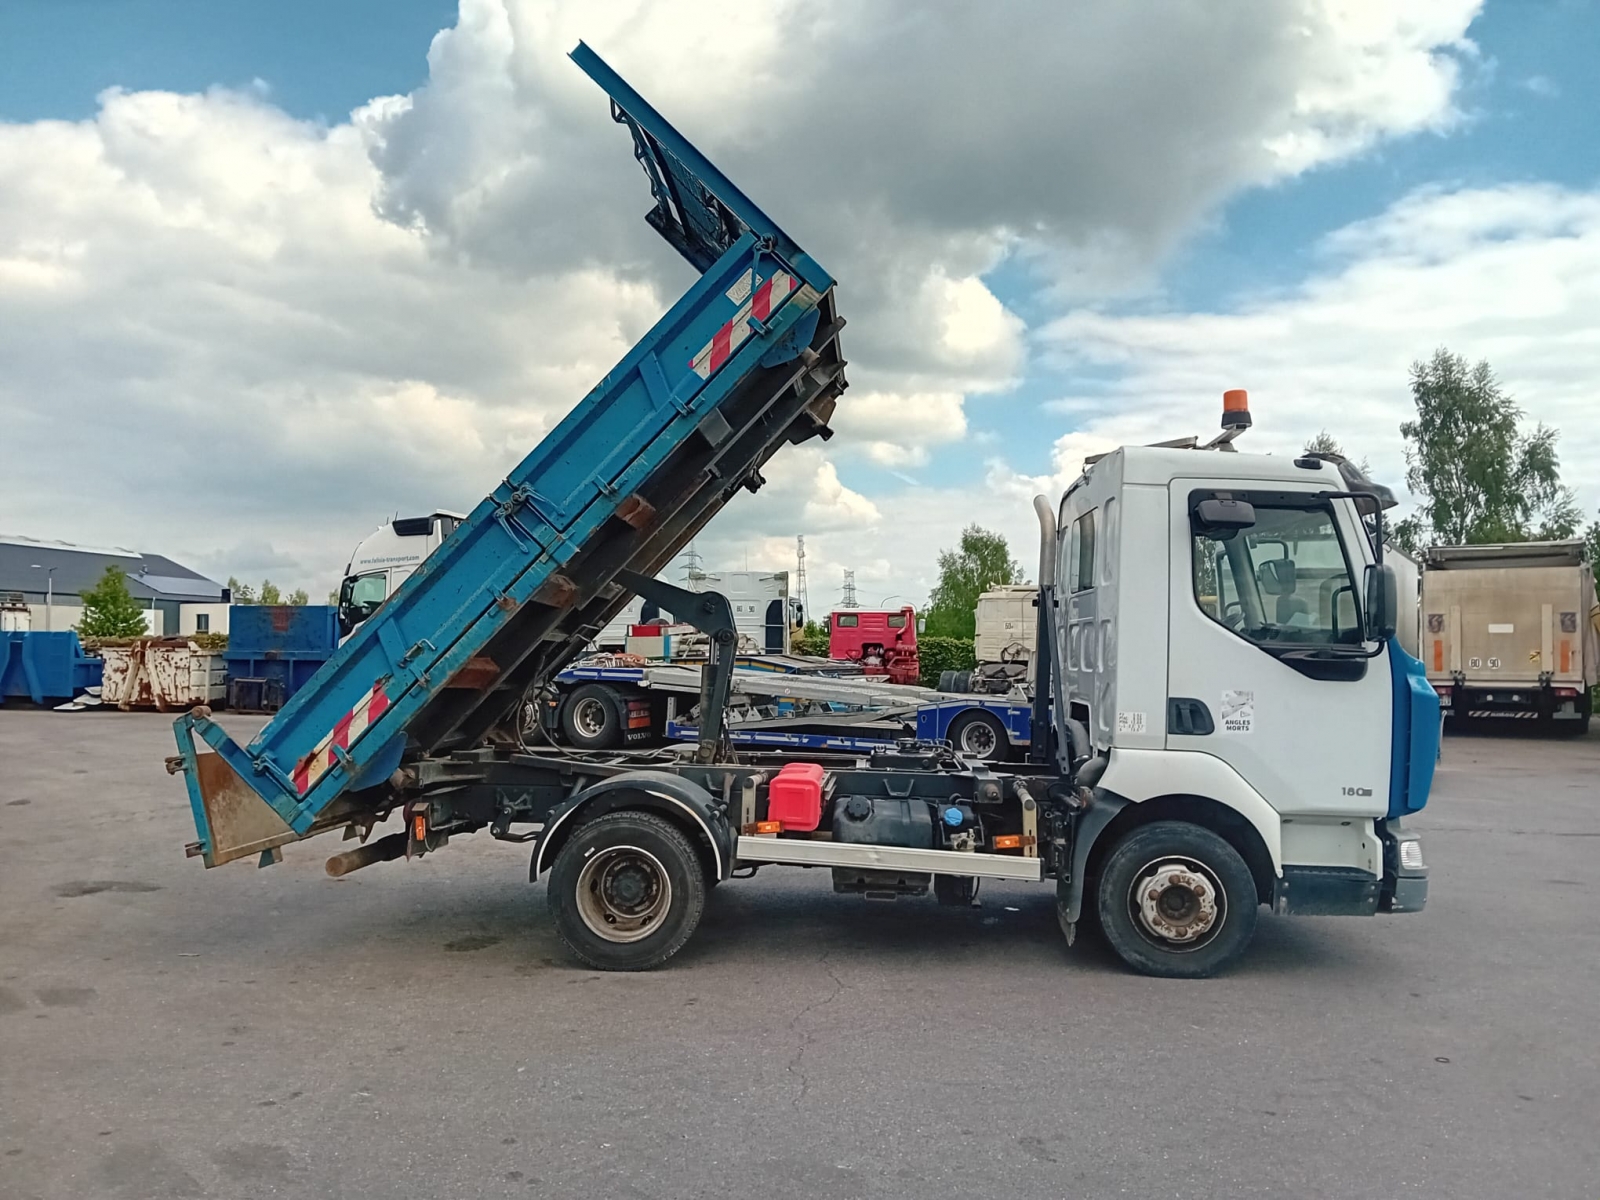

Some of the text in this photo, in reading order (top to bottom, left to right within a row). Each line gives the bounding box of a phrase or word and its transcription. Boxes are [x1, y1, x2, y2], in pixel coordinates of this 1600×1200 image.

[1470, 659, 1480, 667] 80
[1489, 659, 1499, 667] 90
[627, 732, 651, 741] VOLVO
